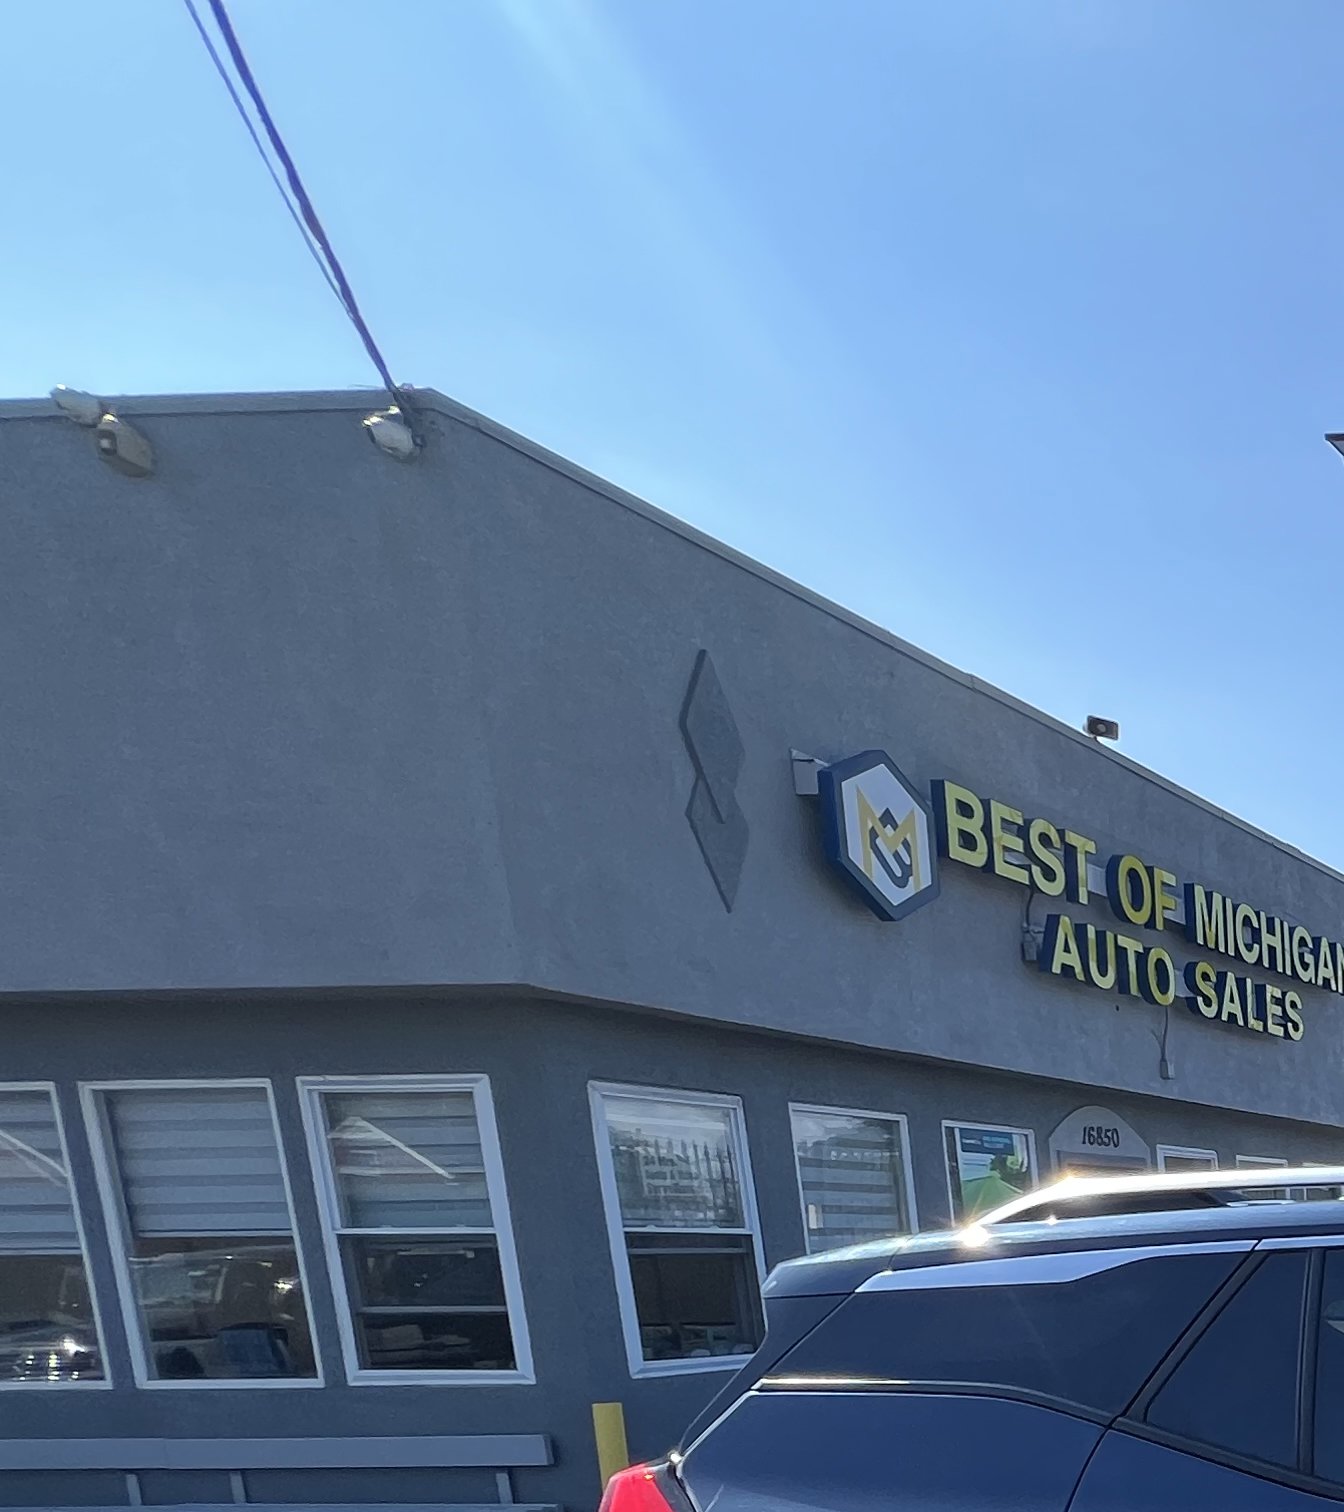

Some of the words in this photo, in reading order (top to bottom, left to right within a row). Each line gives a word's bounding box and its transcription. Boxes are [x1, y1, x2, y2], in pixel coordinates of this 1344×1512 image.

[942, 779, 1097, 906] BEST
[1116, 854, 1177, 931] OF
[1050, 914, 1177, 1007] AUTO
[1193, 960, 1304, 1042] SALES
[1081, 1125, 1121, 1149] 16850
